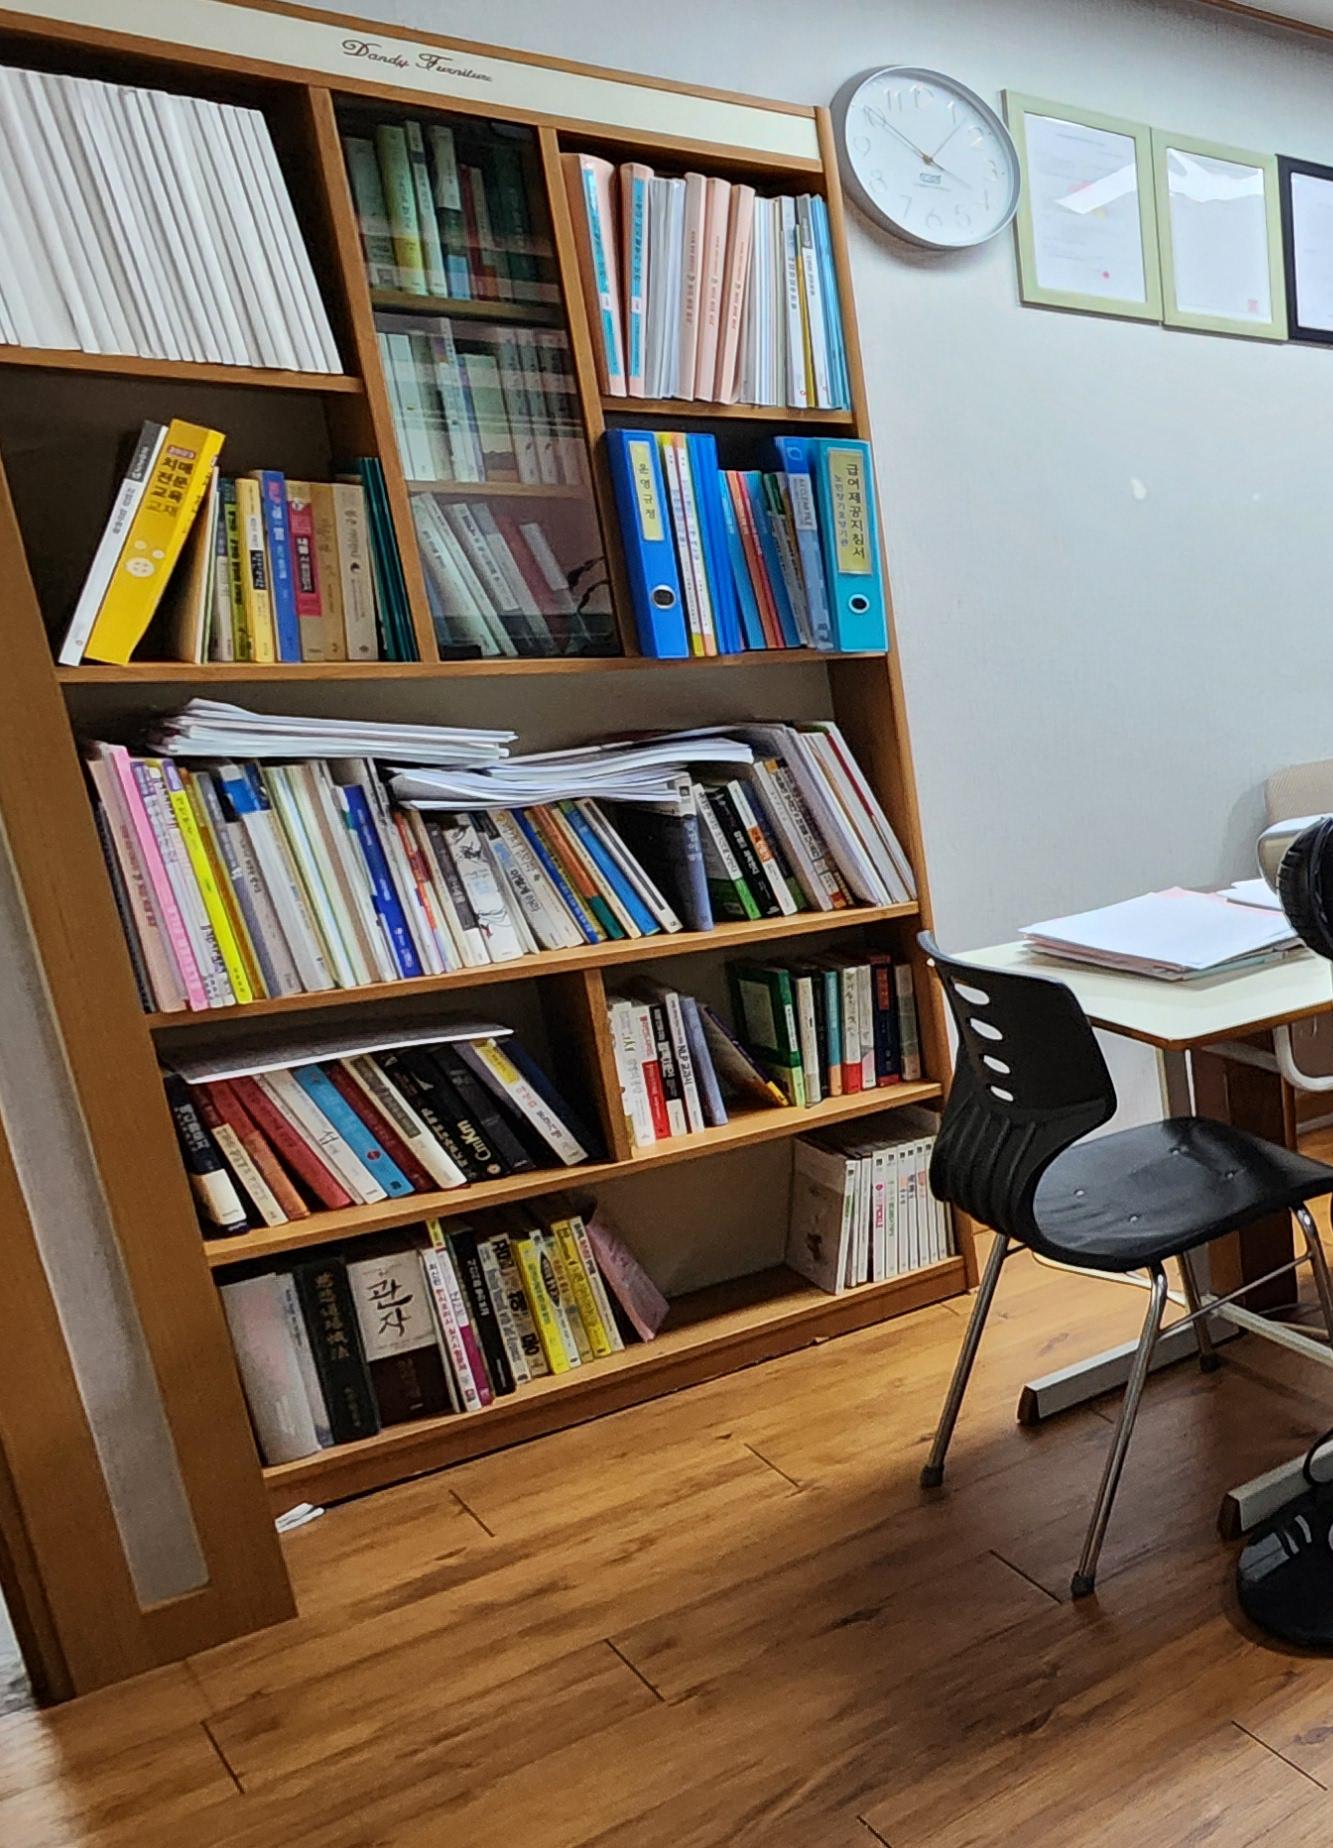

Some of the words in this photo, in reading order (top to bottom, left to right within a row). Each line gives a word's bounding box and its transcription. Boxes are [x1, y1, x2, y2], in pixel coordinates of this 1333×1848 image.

[342, 39, 410, 68] Dandy
[415, 53, 493, 82] Furniture
[156, 470, 189, 487] 전문
[162, 456, 194, 476] 치매
[150, 485, 184, 504] 교육
[638, 463, 656, 520] 운영규정
[846, 463, 866, 559] 급여제공지침서
[366, 1279, 414, 1337] 관자
